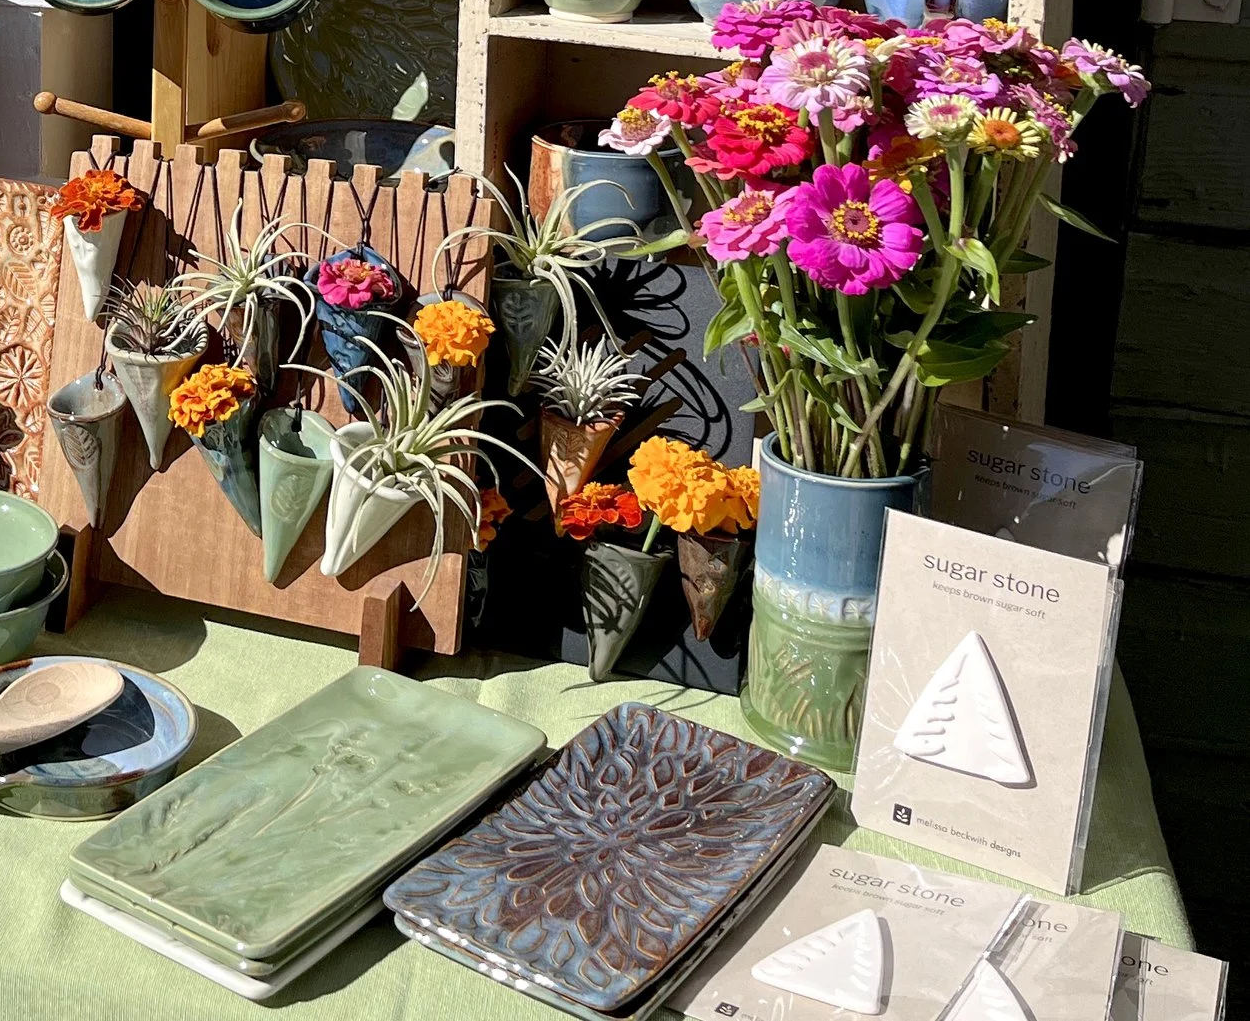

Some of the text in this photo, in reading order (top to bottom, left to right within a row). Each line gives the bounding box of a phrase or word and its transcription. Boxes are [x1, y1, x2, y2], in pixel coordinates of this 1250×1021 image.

[966, 449, 1091, 494] sugar stone
[1002, 481, 1030, 496] brown
[1057, 497, 1077, 510] soft
[922, 554, 1061, 603] sugar stone
[932, 580, 1046, 620] keeps brown sugar soft
[916, 817, 1022, 858] melissa beckwith designs
[829, 867, 966, 908] sugar stone
[862, 890, 893, 903] brown
[1021, 918, 1068, 933] one
[1121, 956, 1169, 976] one
